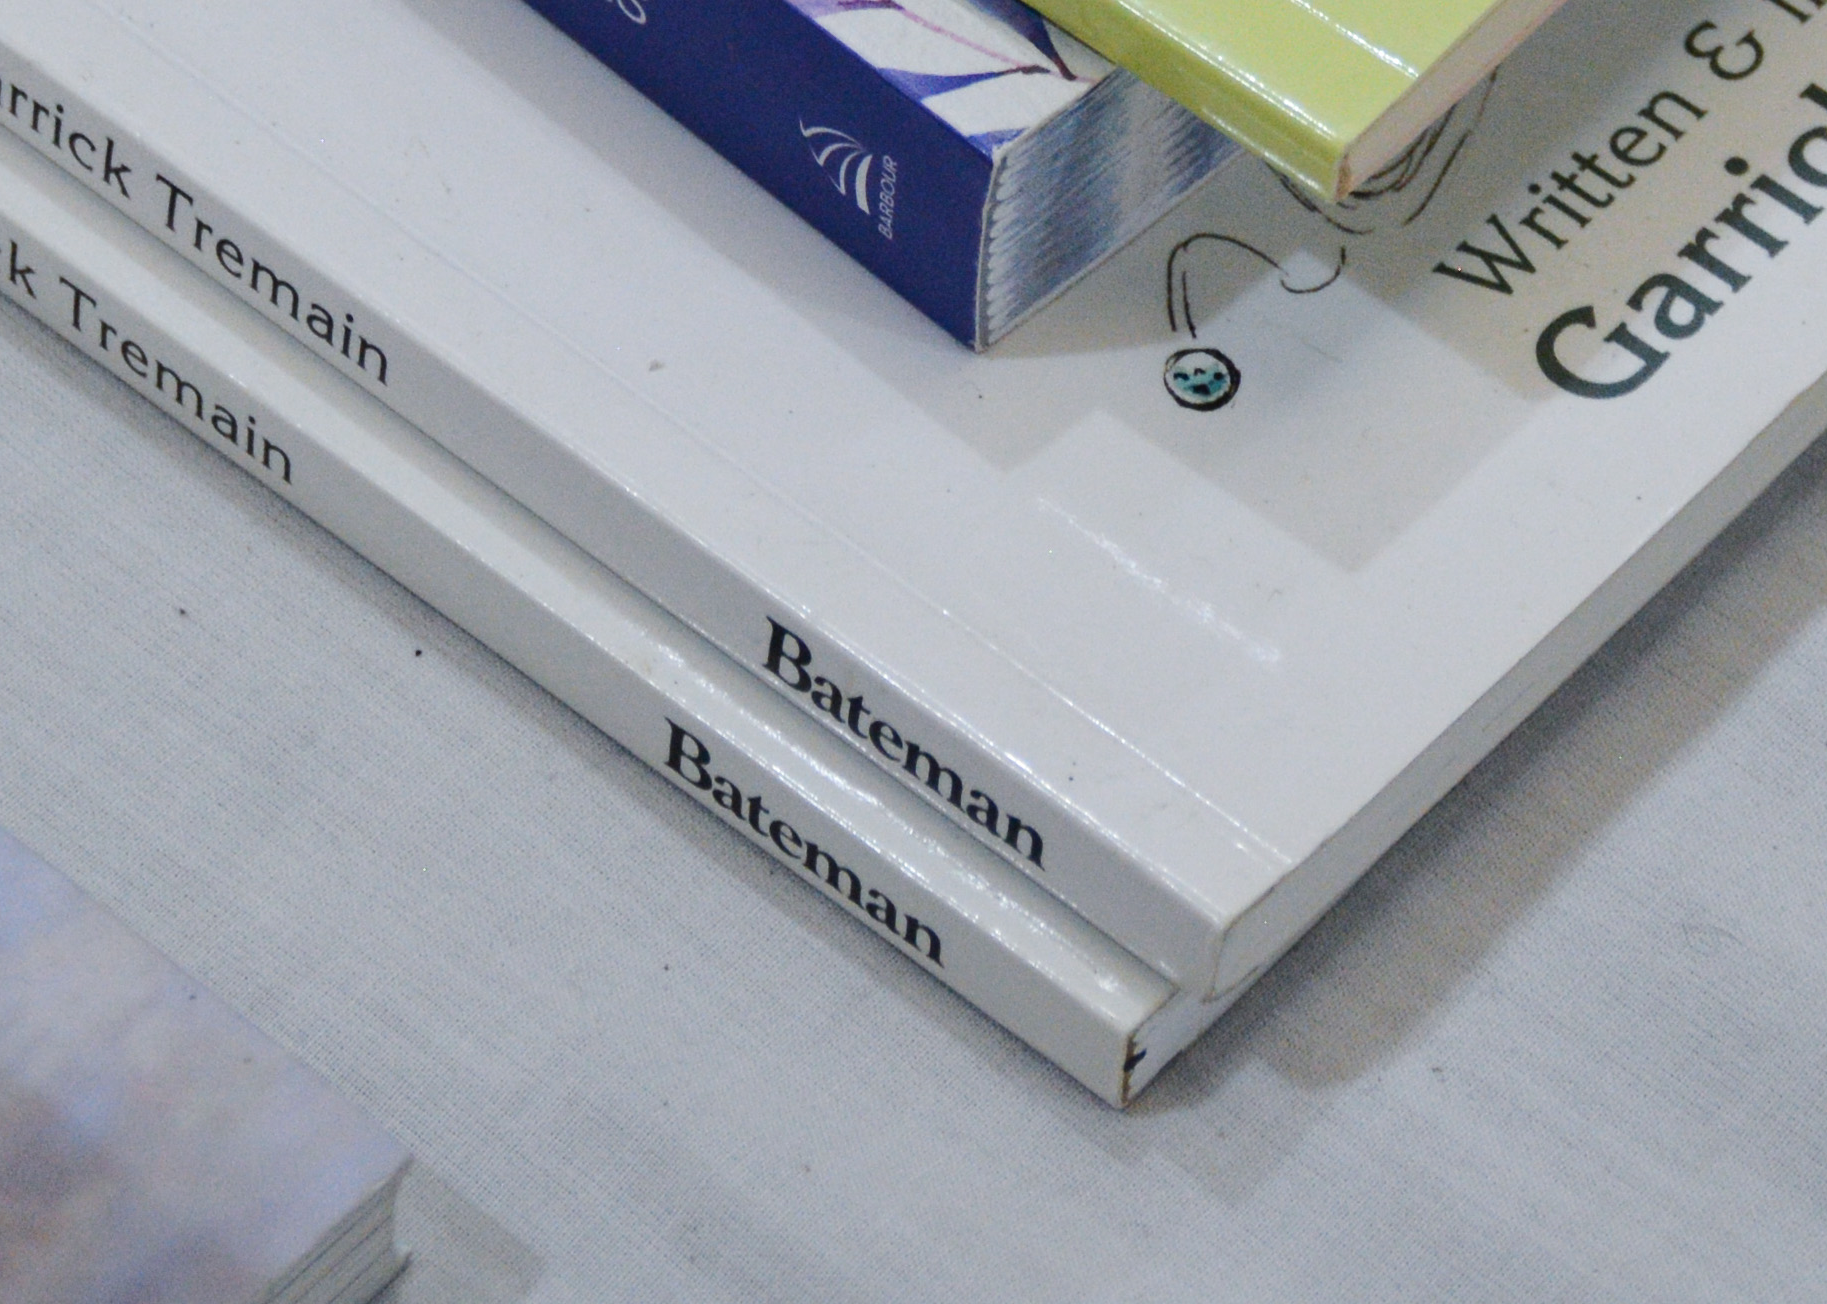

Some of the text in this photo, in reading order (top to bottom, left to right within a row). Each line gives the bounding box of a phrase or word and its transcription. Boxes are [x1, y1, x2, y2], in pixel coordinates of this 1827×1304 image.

[155, 172, 389, 388] Tremain
[877, 154, 899, 242] BARBOUR
[1431, 70, 1708, 310] Written
[1680, 17, 1770, 86] &
[58, 276, 294, 486] Tremain
[662, 714, 946, 970] Bateman
[760, 614, 1047, 873] Bateman
